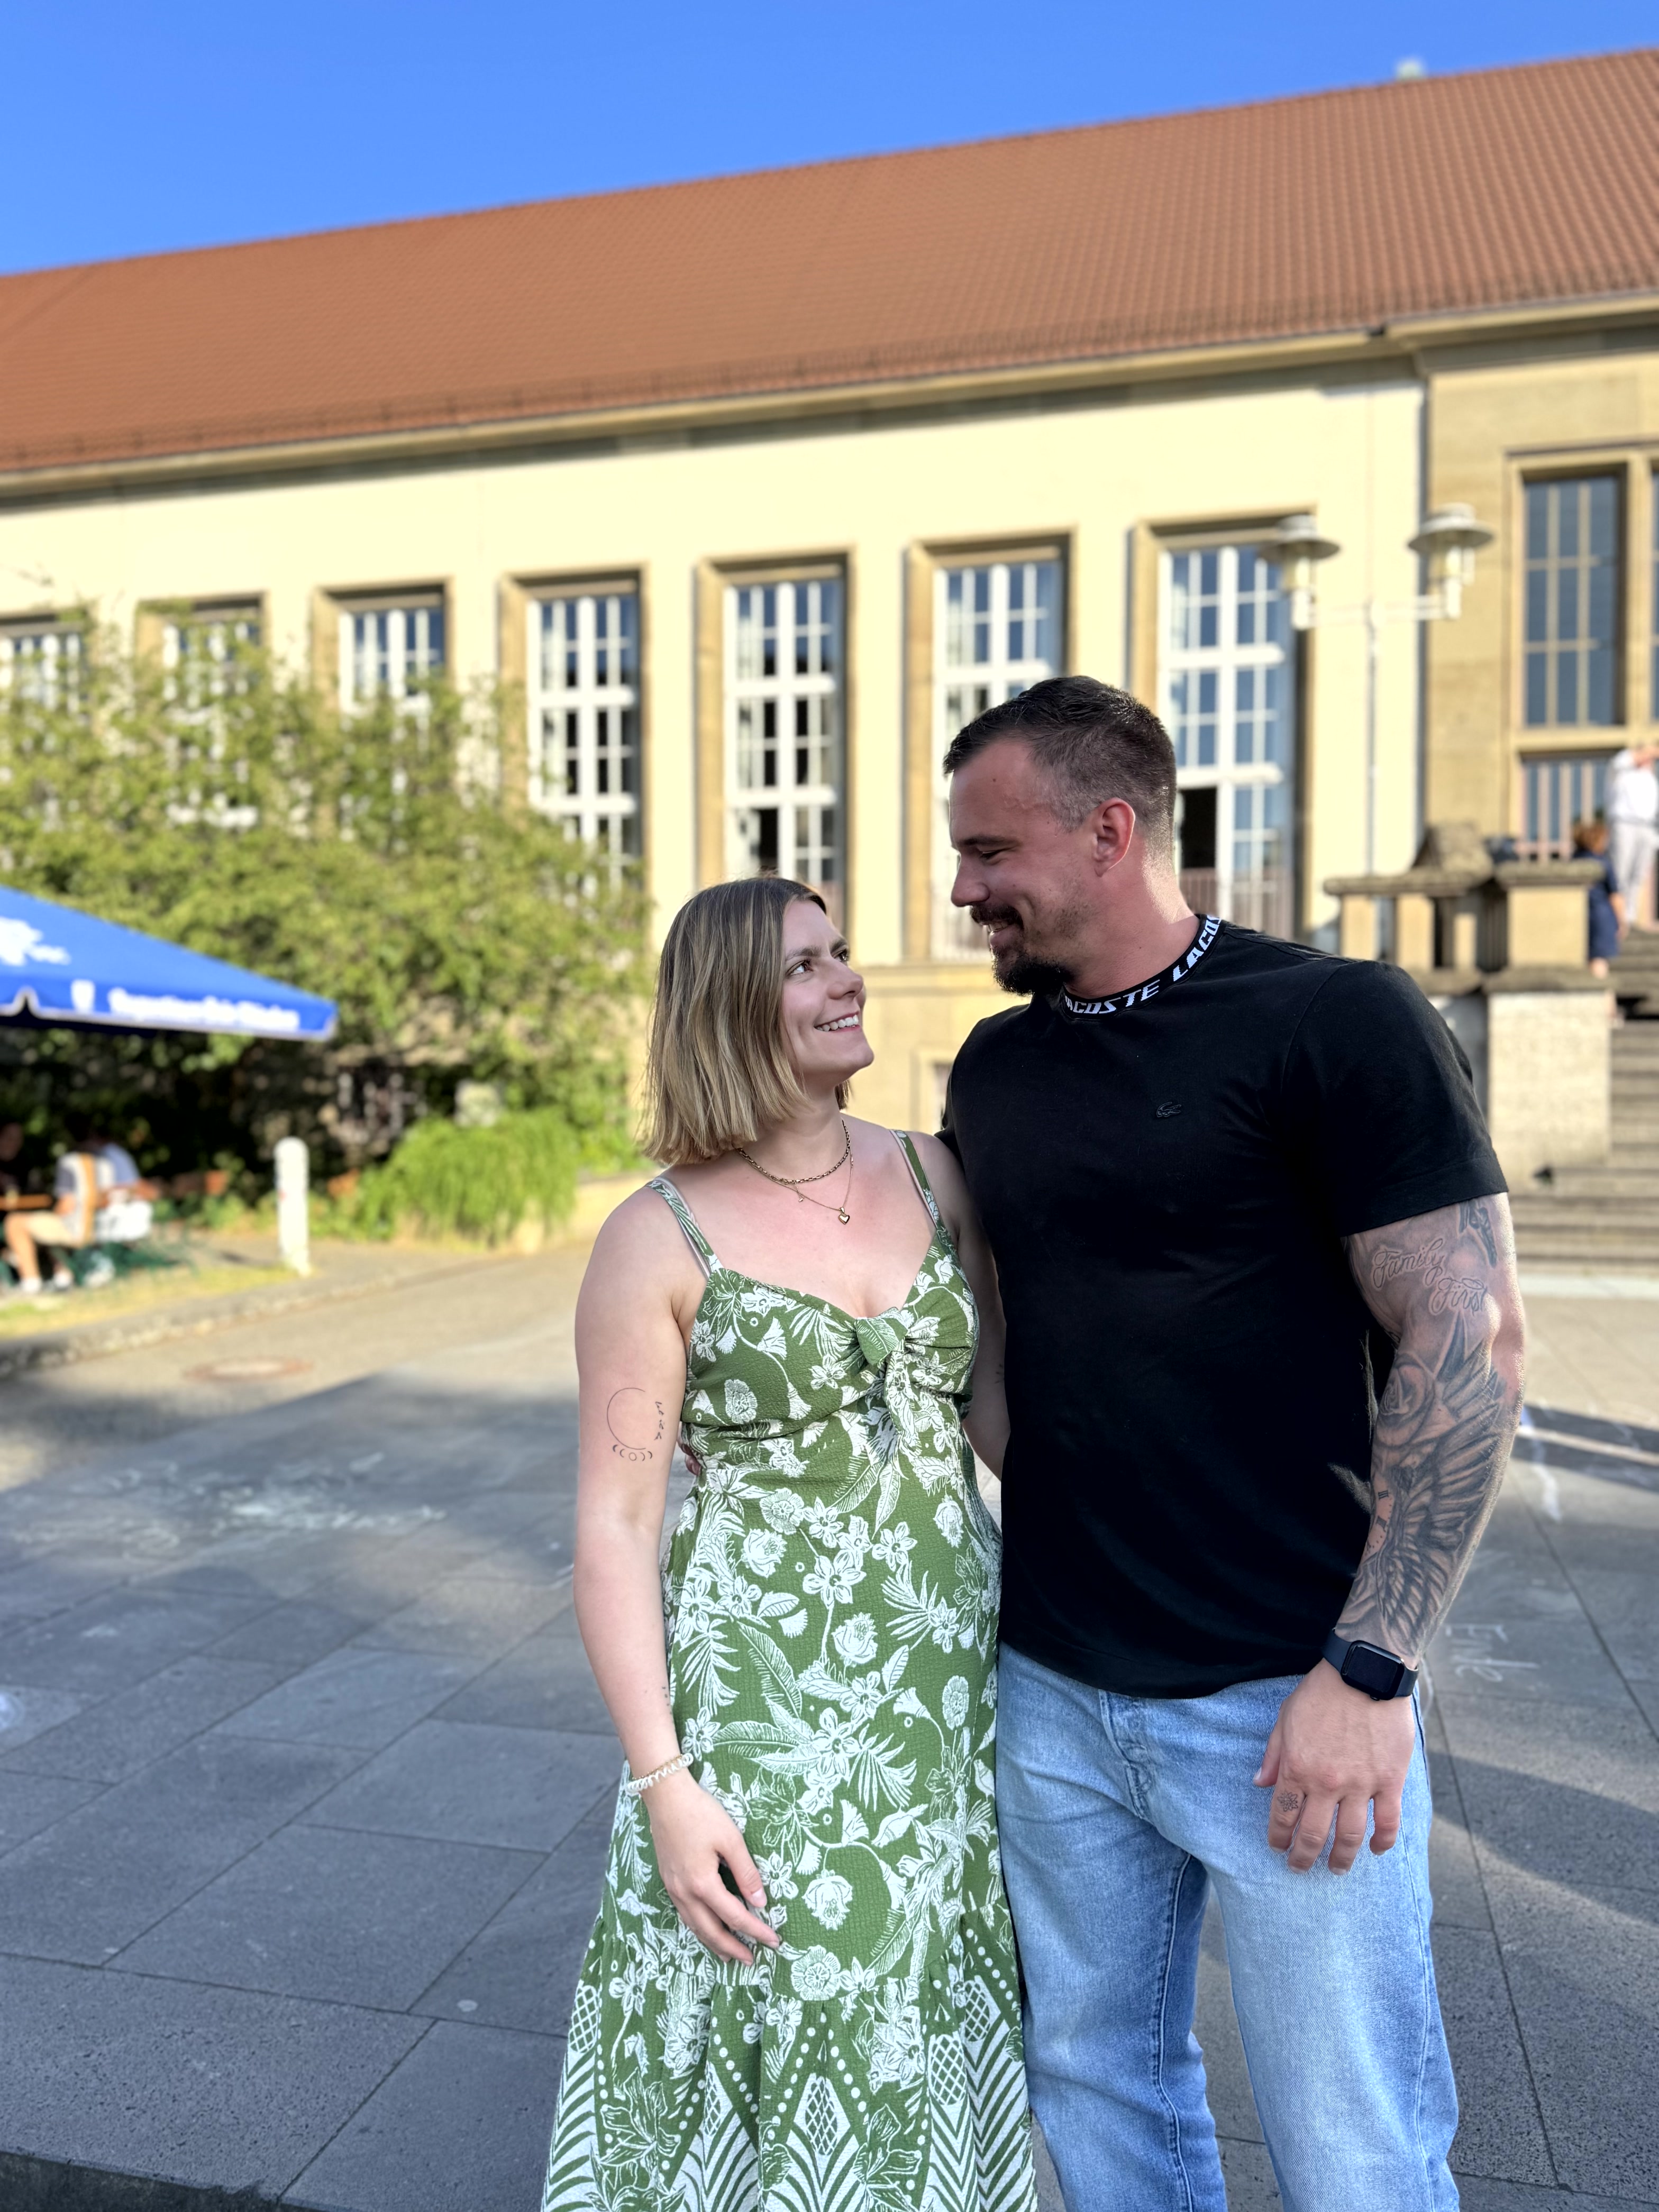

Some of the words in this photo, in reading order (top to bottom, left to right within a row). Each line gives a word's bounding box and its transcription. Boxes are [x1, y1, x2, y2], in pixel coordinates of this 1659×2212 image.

[1065, 979, 1160, 1014] ACOSTE
[1373, 1238, 1445, 1288] Family
[1432, 1277, 1488, 1316] First
